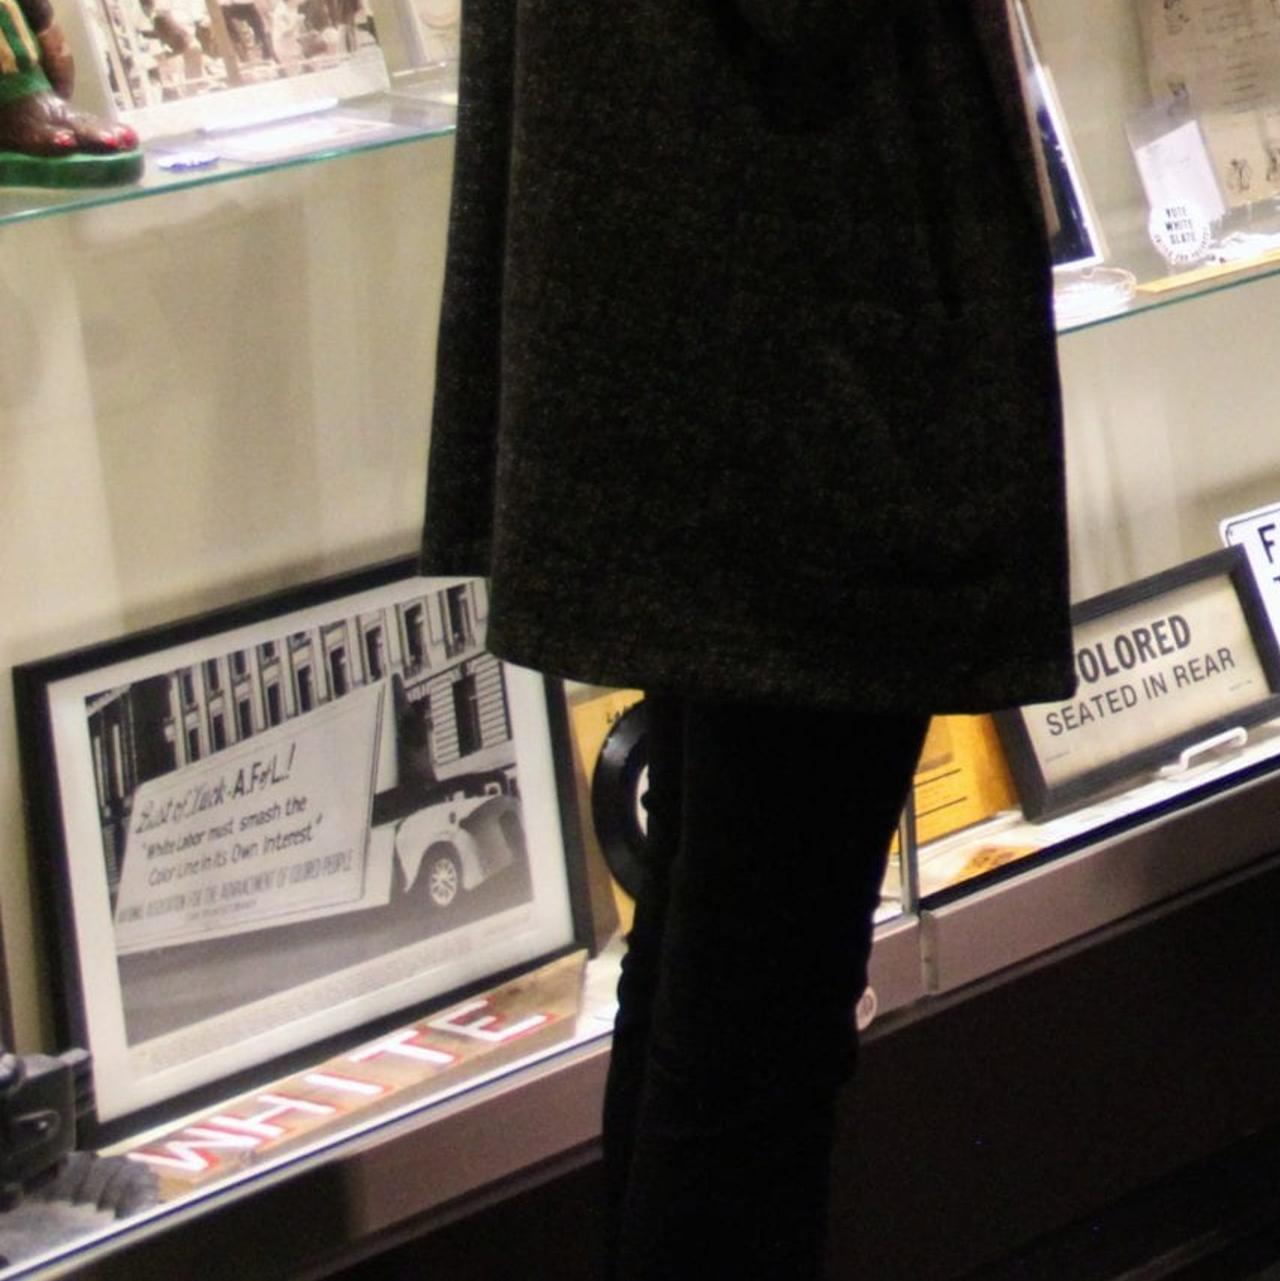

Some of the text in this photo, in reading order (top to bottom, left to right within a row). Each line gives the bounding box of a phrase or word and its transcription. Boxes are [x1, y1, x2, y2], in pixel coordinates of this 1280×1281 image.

[1076, 615, 1191, 685] OLORED
[1046, 647, 1236, 737] SEATED IN REAR
[285, 795, 308, 817] the
[126, 995, 557, 1176] WHITE
